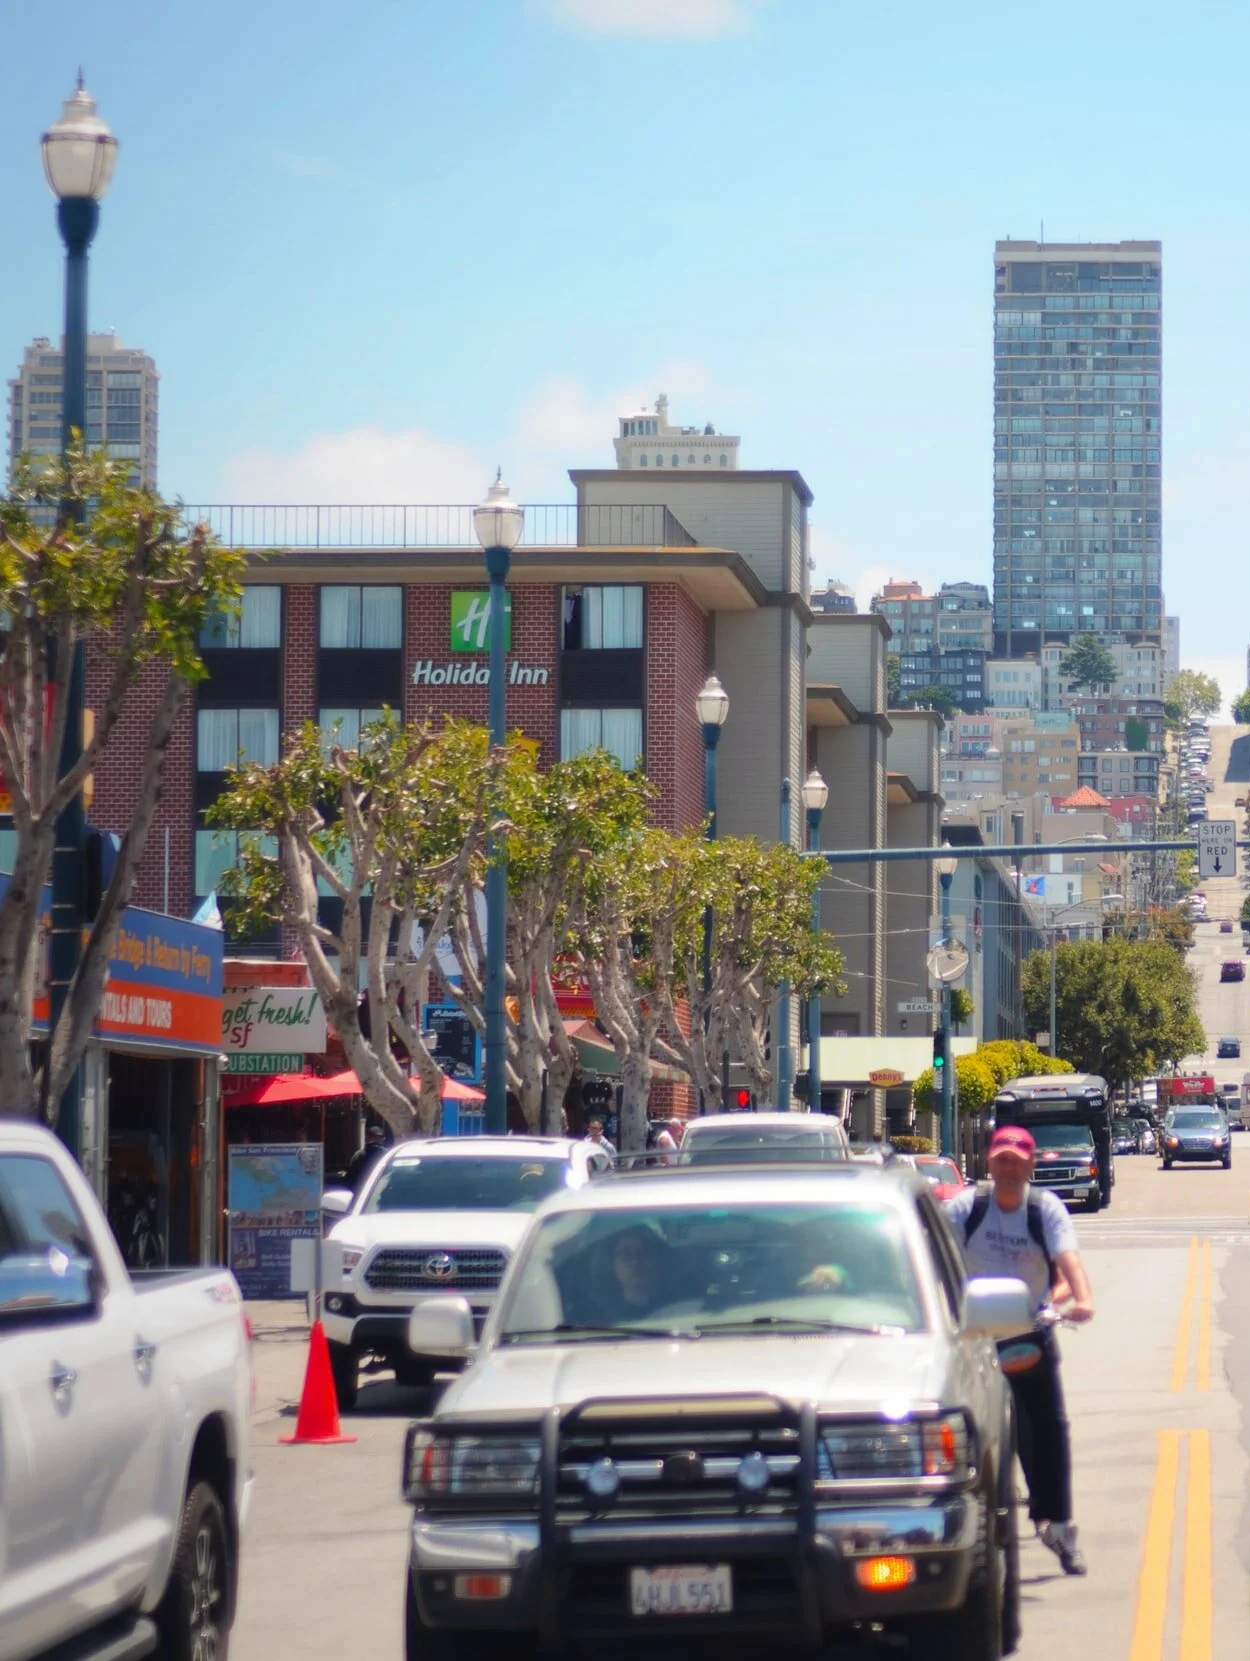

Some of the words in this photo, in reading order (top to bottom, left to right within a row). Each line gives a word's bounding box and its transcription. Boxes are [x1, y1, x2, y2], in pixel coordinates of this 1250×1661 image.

[412, 661, 491, 685] Holida
[510, 661, 549, 685] Inn
[1203, 825, 1231, 835] STOP
[1207, 846, 1228, 856] RED
[118, 928, 144, 971] Bridge
[192, 945, 212, 985] Ferry
[127, 996, 145, 1025] AND
[145, 998, 172, 1029] TOURS
[222, 999, 258, 1034] get
[258, 993, 318, 1025] fresh!
[226, 1056, 300, 1072] UBSTATION
[872, 1073, 902, 1081] Denny's
[258, 1229, 279, 1237] BIKE
